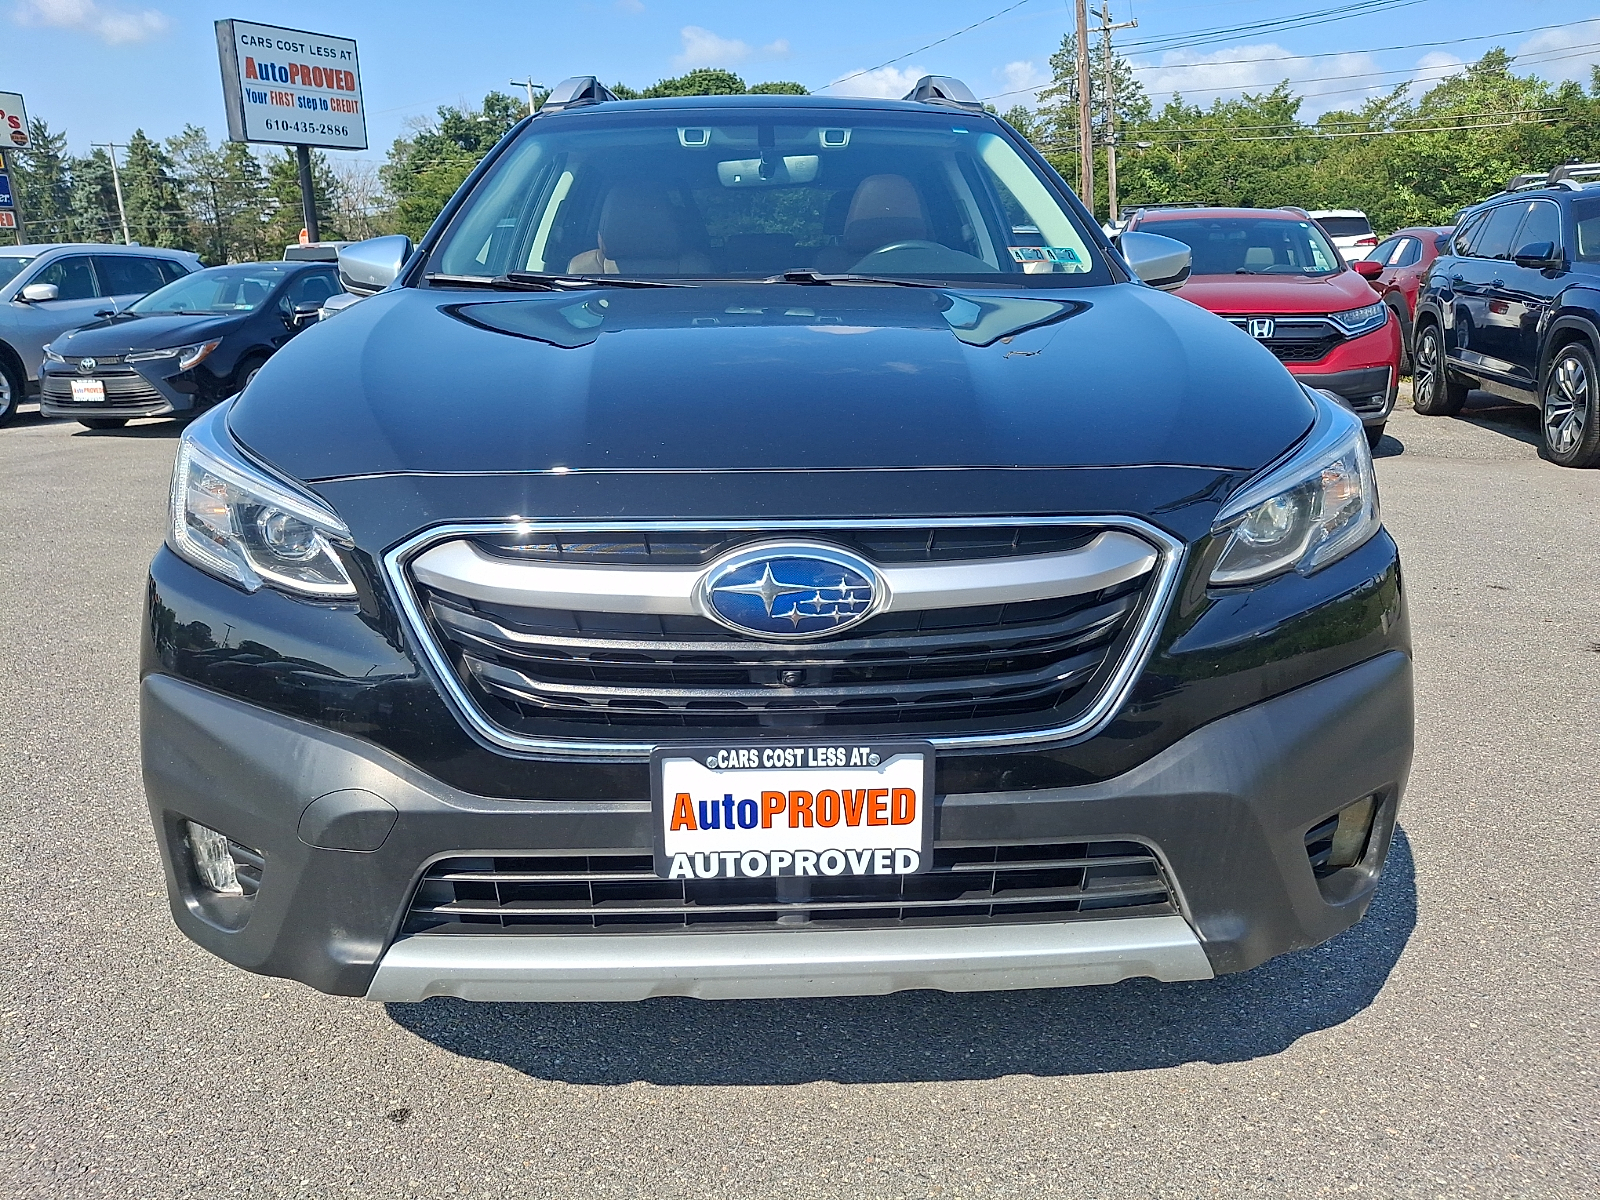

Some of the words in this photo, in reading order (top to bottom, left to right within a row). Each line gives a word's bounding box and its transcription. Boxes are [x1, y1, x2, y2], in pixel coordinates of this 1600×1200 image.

[241, 35, 273, 49] CARS
[276, 40, 305, 53] COST
[309, 45, 337, 58] LESS
[339, 50, 352, 61] AT
[245, 56, 356, 91] AutoPROVED
[245, 88, 267, 105] Your
[270, 90, 295, 107] FIRST
[297, 95, 317, 111] step
[319, 97, 329, 111] to
[330, 97, 359, 114] CREDIT
[265, 118, 349, 137] 610-435-2886
[717, 749, 759, 769] CARS
[763, 748, 804, 768] COST
[808, 747, 846, 767] LESS
[849, 747, 870, 766] AT
[669, 787, 917, 831] AutoPROVED
[668, 848, 920, 879] AUTOPROVED
